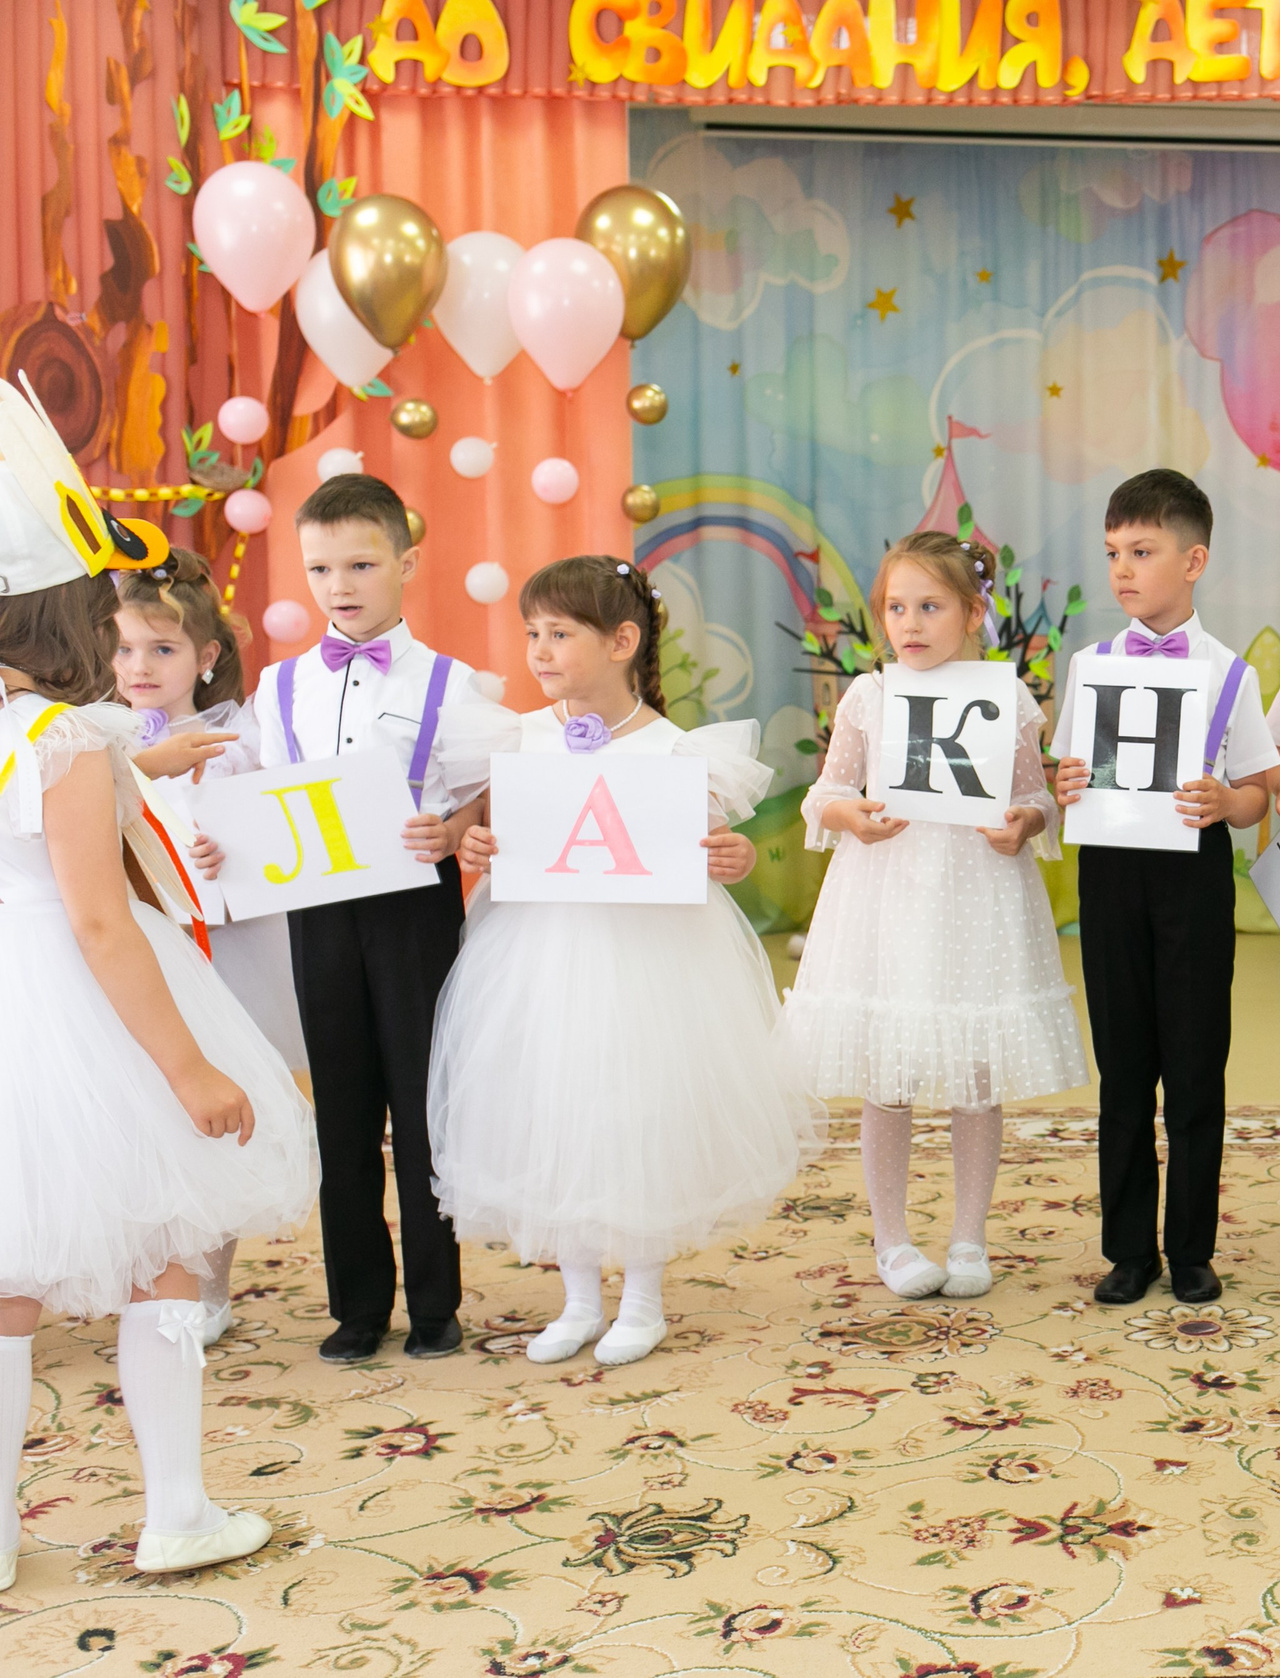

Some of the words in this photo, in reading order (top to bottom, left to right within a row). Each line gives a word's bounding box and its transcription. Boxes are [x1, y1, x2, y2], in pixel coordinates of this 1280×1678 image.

[367, 0, 510, 87] ДО
[888, 694, 1001, 799] К
[1082, 683, 1198, 792] Н
[261, 777, 371, 886] Л
[545, 773, 653, 877] А
